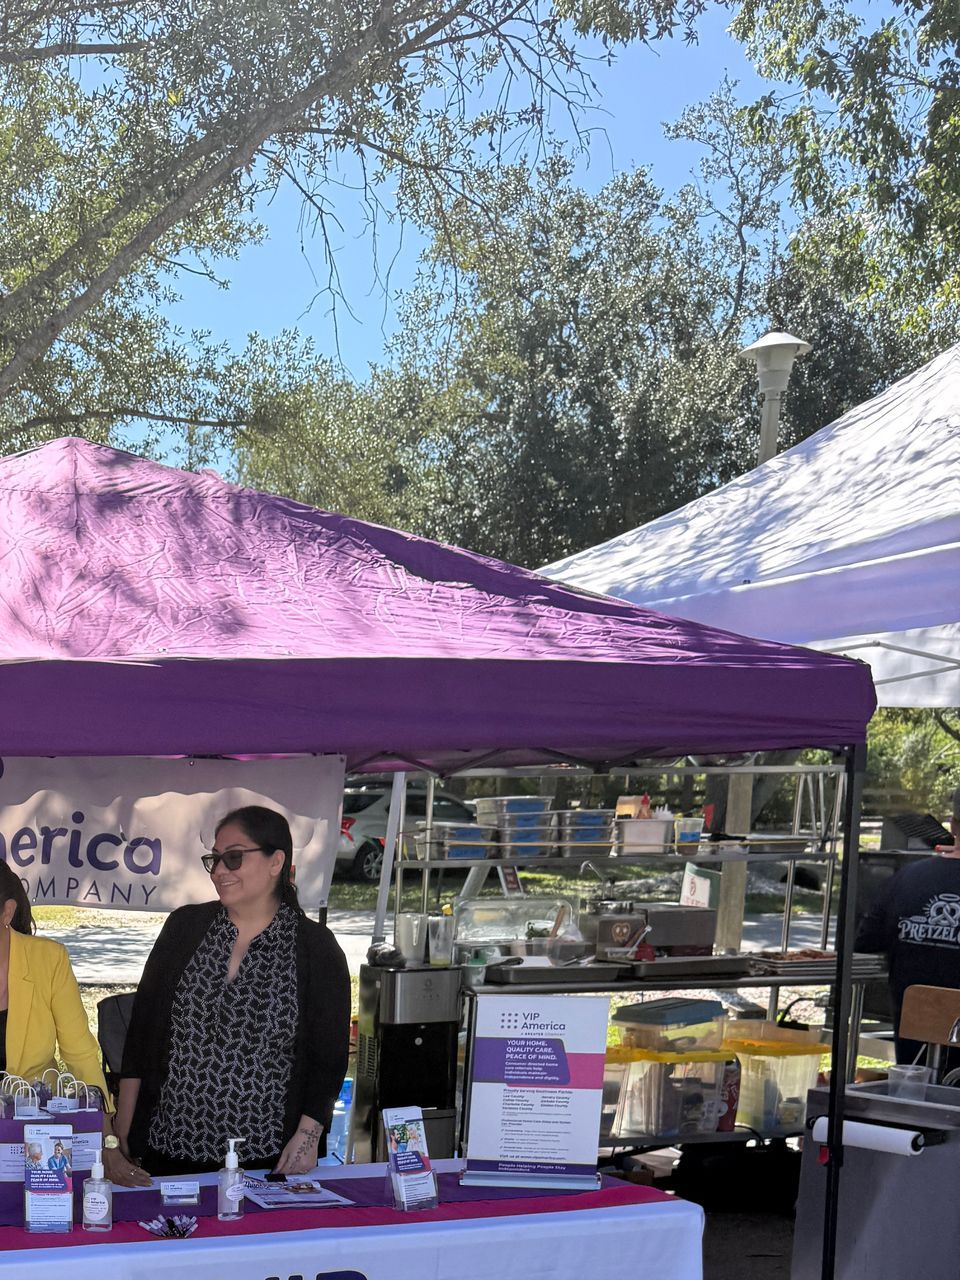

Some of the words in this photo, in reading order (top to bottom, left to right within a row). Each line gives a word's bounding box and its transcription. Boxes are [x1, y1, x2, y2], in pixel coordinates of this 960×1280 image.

[897, 920, 957, 942] PRETZEL
[522, 1012, 540, 1021] VIP
[521, 1021, 566, 1031] America
